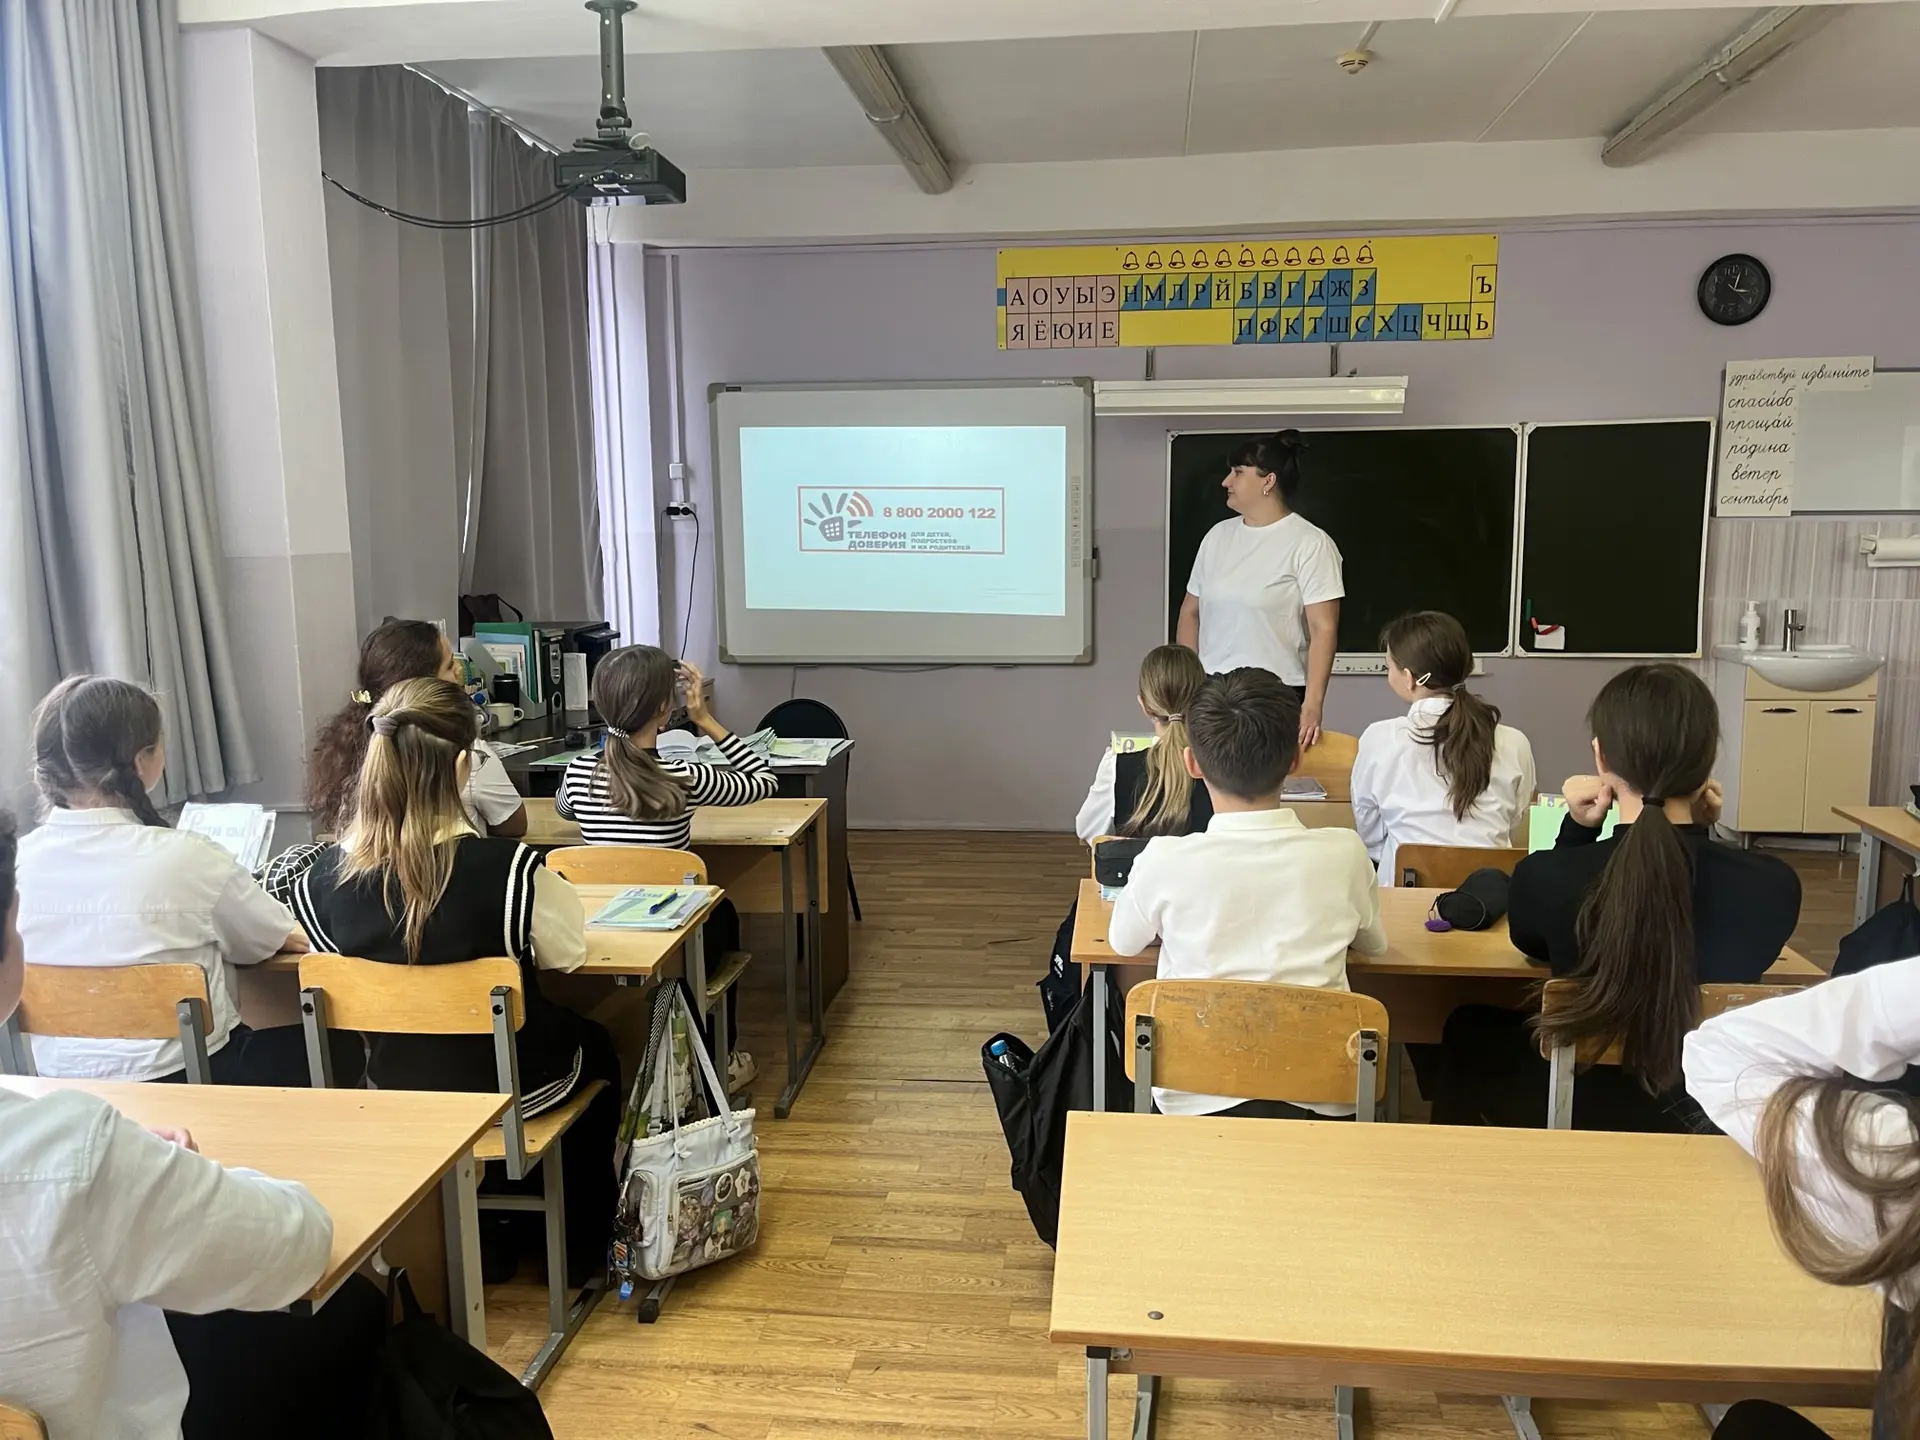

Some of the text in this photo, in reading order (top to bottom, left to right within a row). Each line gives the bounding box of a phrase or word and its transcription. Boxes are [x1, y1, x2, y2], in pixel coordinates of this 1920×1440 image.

[1010, 276, 1492, 306] А О У Ы Э Н М Л Р Й Б В Г Д Ж З Ъ
[1011, 314, 1489, 341] Я Ё Ю И Е П Ф К Т Ш С Х Ц Ч Щ Ь
[884, 507, 996, 519] 8 800 2000 122
[848, 531, 906, 540] ТЕЛЕФОН
[848, 541, 906, 550] ДОВЕРИЯ
